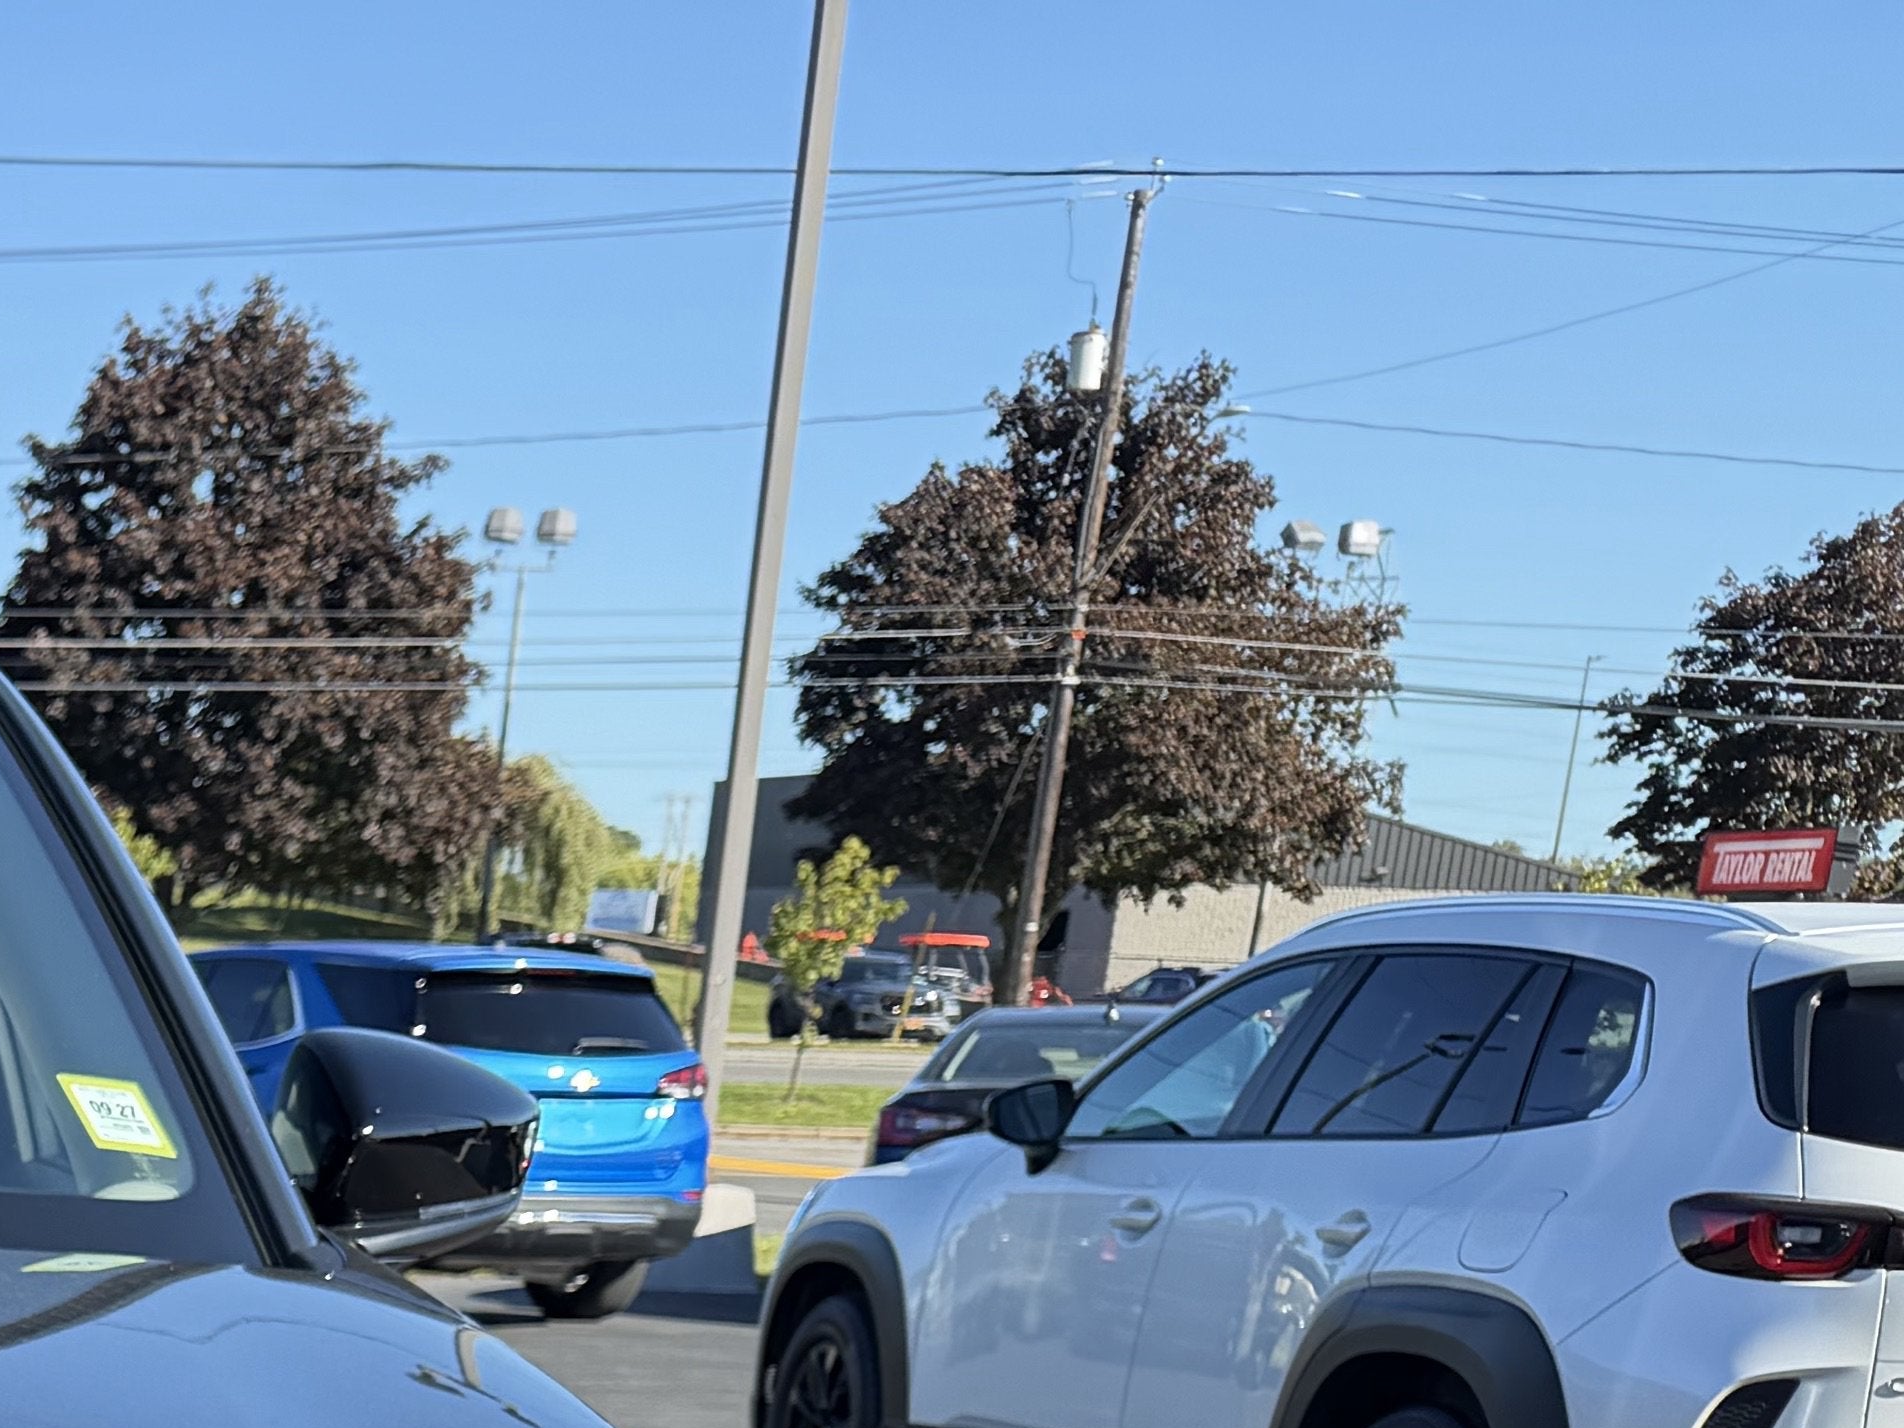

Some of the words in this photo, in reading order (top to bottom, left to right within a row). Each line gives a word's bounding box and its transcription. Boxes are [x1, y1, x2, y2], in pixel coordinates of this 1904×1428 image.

[1712, 843, 1765, 884] TAYLOR
[1763, 849, 1816, 883] RENTAL
[89, 1100, 112, 1116] 09
[115, 1103, 137, 1119] 27
